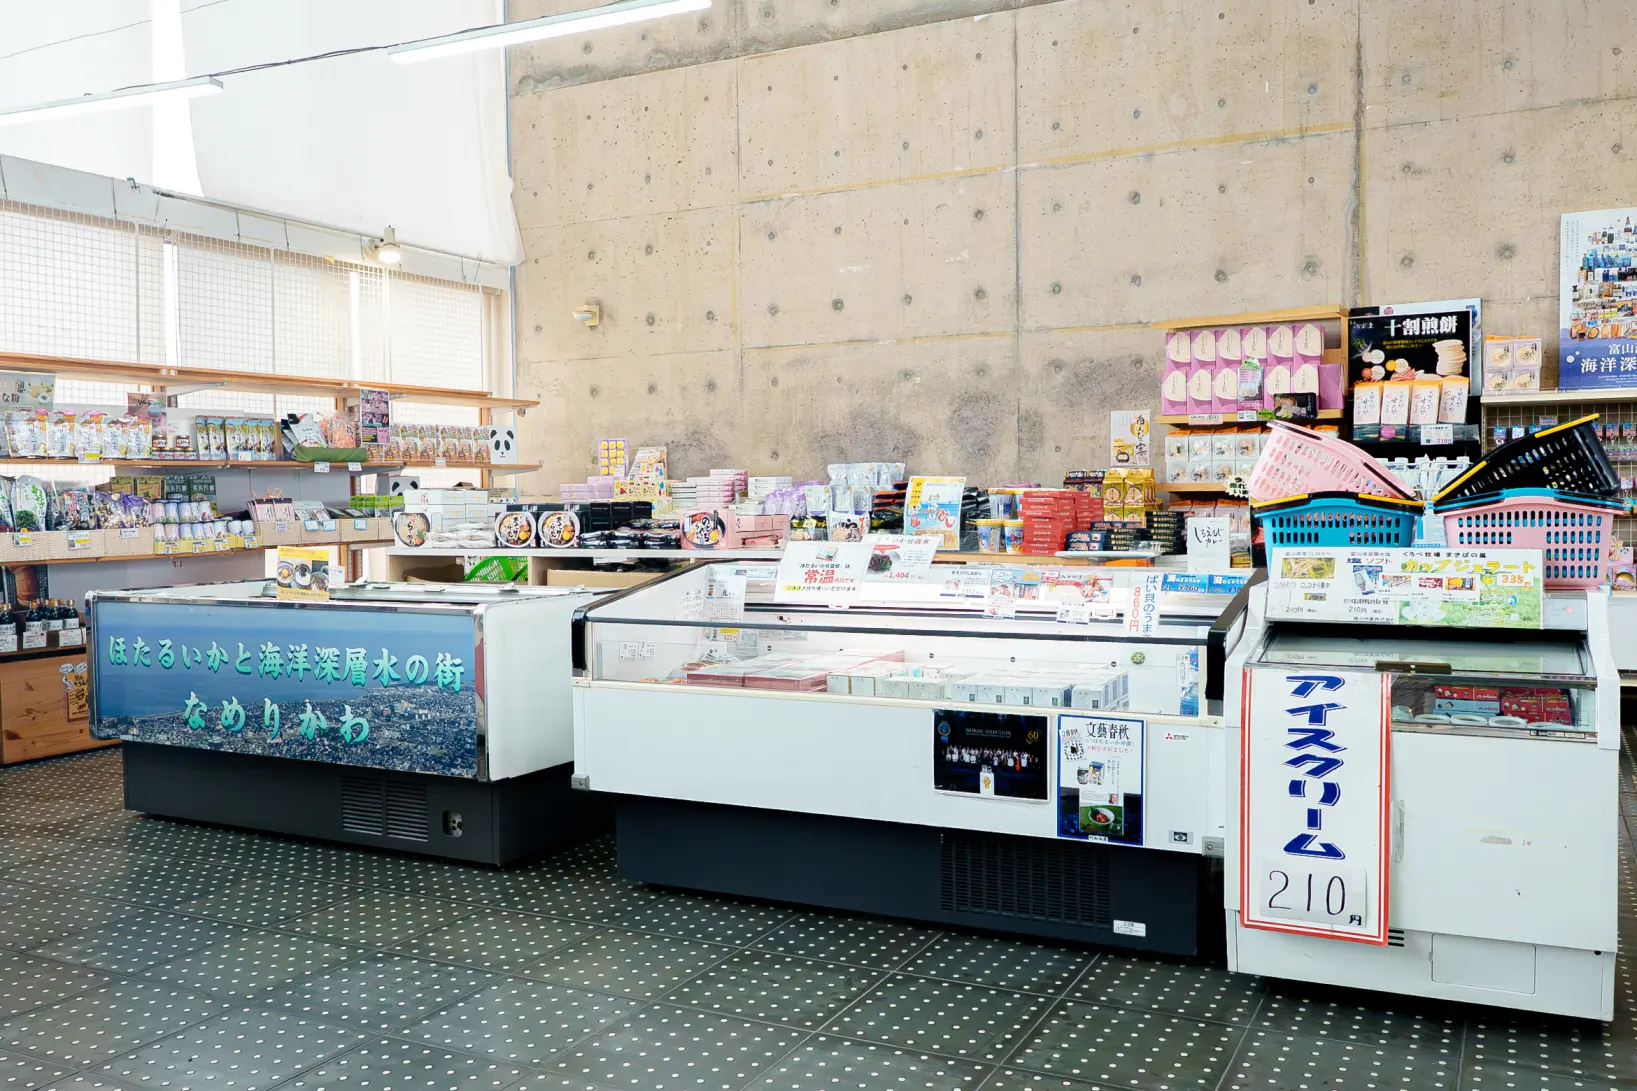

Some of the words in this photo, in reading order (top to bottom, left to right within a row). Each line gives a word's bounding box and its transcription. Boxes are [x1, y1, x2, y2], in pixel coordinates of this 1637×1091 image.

[1384, 315, 1458, 337] 十割煎餅
[1608, 343, 1637, 355] 富山
[1581, 356, 1637, 374] 海洋深
[1402, 559, 1536, 573] カップジェラート
[804, 569, 835, 584] 常温
[1129, 587, 1141, 632] 860円
[108, 635, 465, 693] ほたるいかと海洋深層水の街
[183, 691, 370, 744] なめりかわ
[1027, 731, 1039, 740] 60
[1085, 722, 1129, 740] 文藝春秋
[1282, 675, 1348, 860] アイスクリーム
